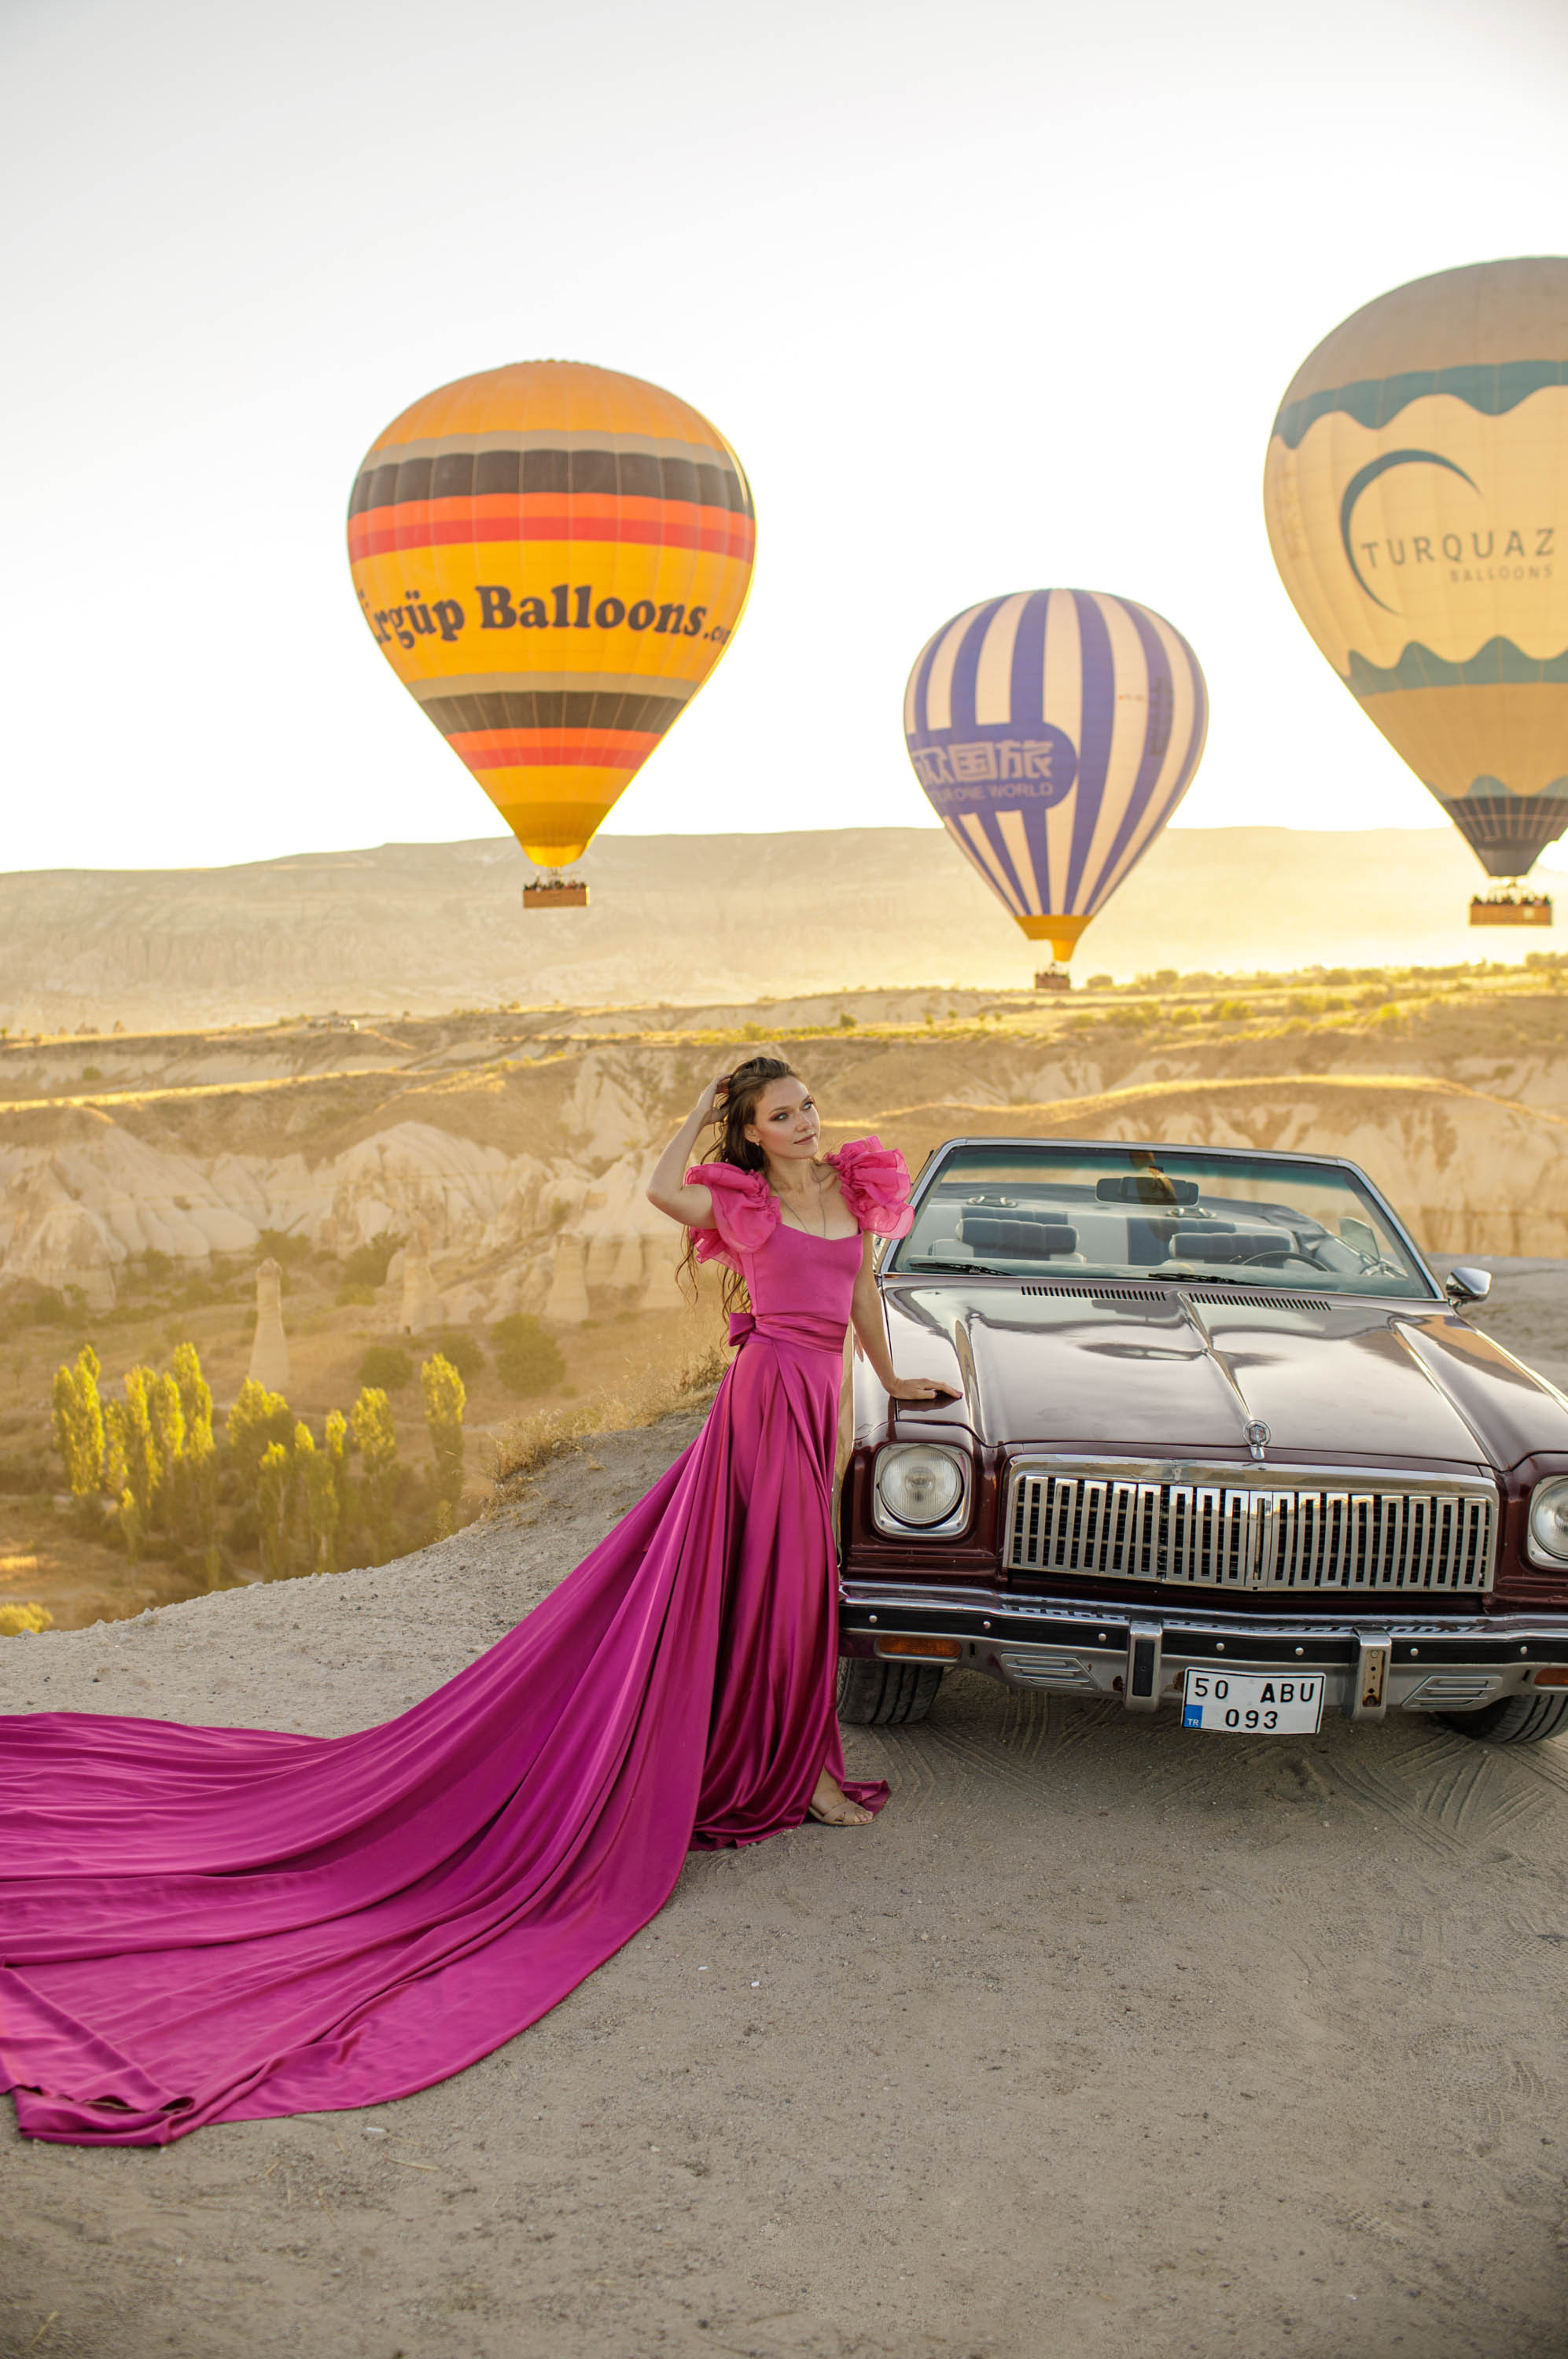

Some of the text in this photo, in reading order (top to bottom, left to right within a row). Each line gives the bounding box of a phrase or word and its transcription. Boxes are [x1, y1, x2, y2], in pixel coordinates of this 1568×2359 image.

[1361, 527, 1555, 569] TURQUAZ
[1450, 563, 1553, 583] BALLOONS
[359, 588, 465, 650] rgüp
[988, 782, 1054, 799] WORLD
[1194, 1677, 1315, 1703] 50 ABU
[1225, 1709, 1278, 1729] 093
